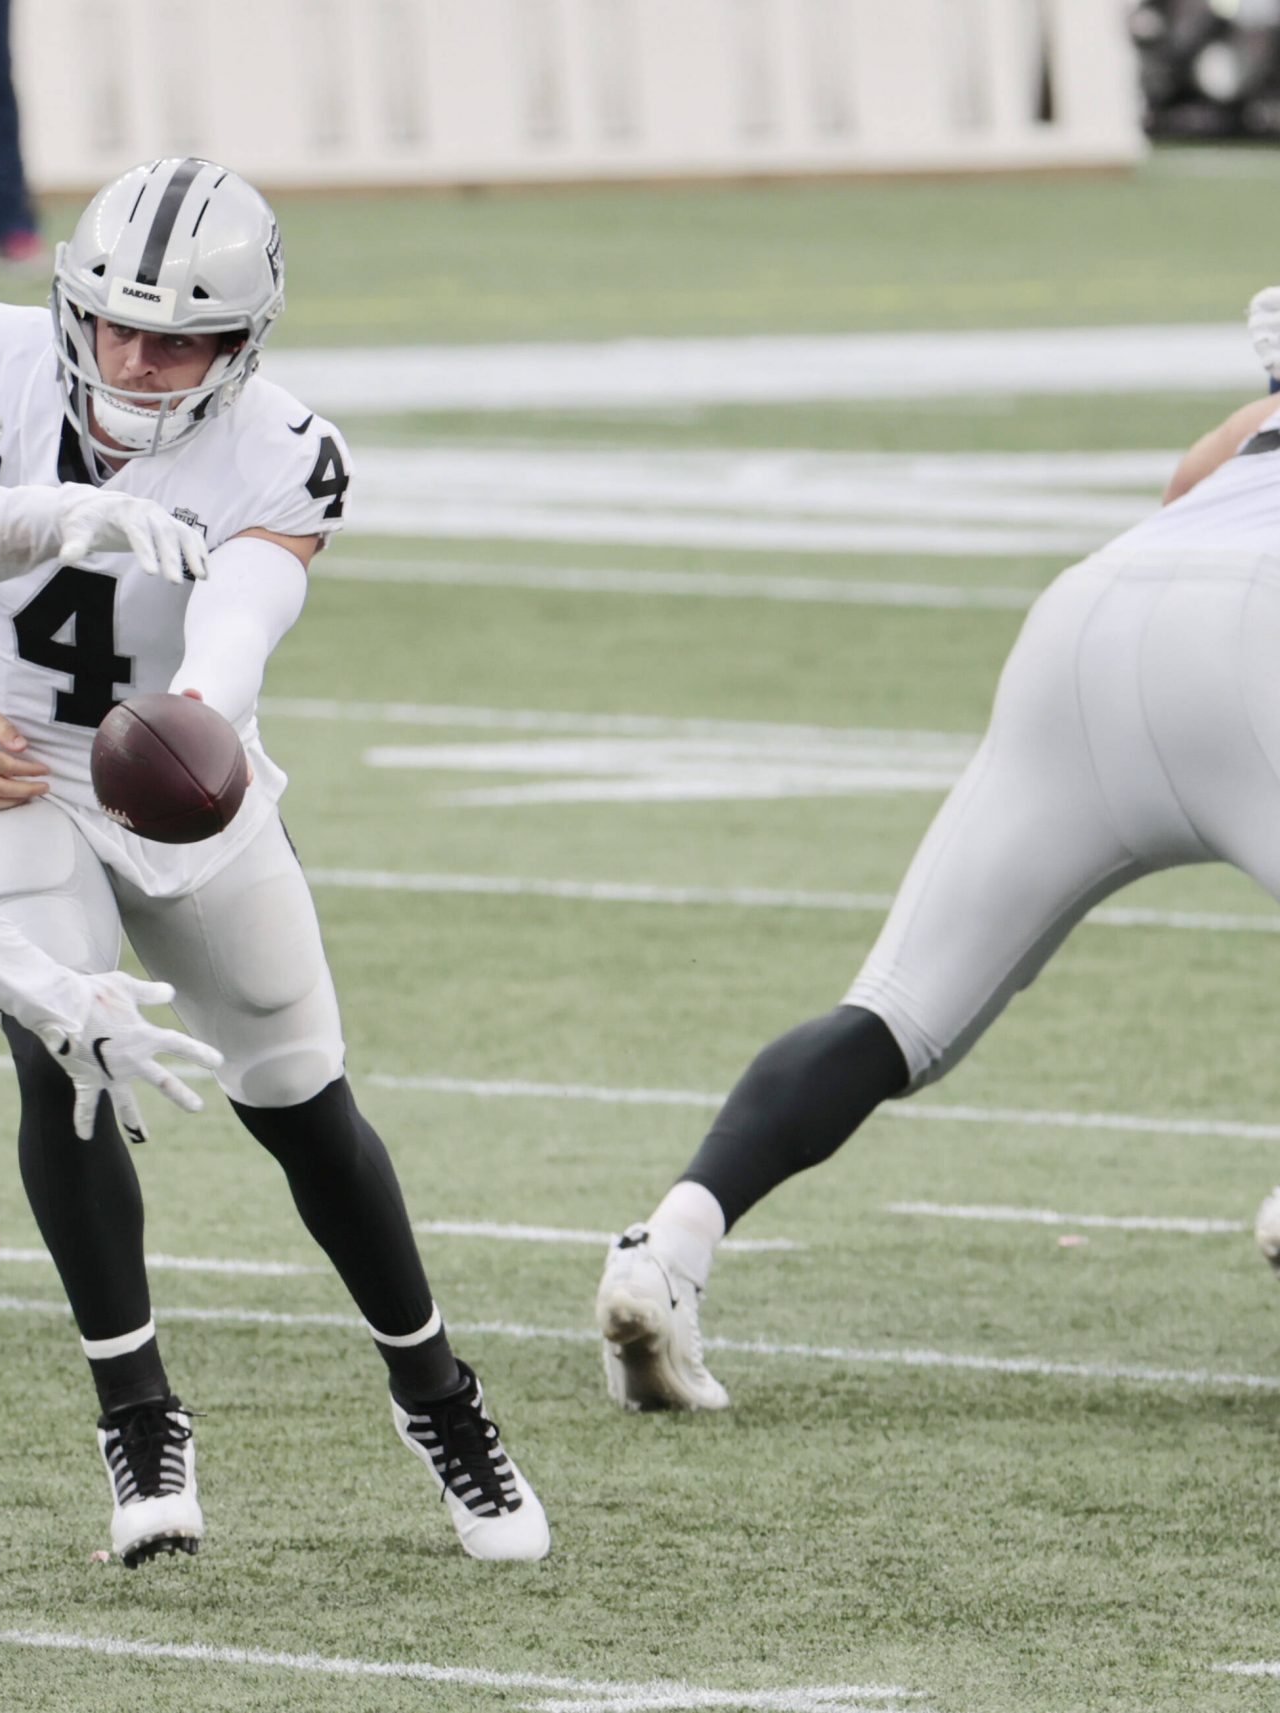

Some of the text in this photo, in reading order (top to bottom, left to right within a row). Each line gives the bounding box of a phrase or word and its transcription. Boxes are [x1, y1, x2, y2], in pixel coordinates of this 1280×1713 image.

[122, 286, 161, 302] RAIDERS
[304, 435, 351, 520] 4
[11, 564, 137, 729] 4
